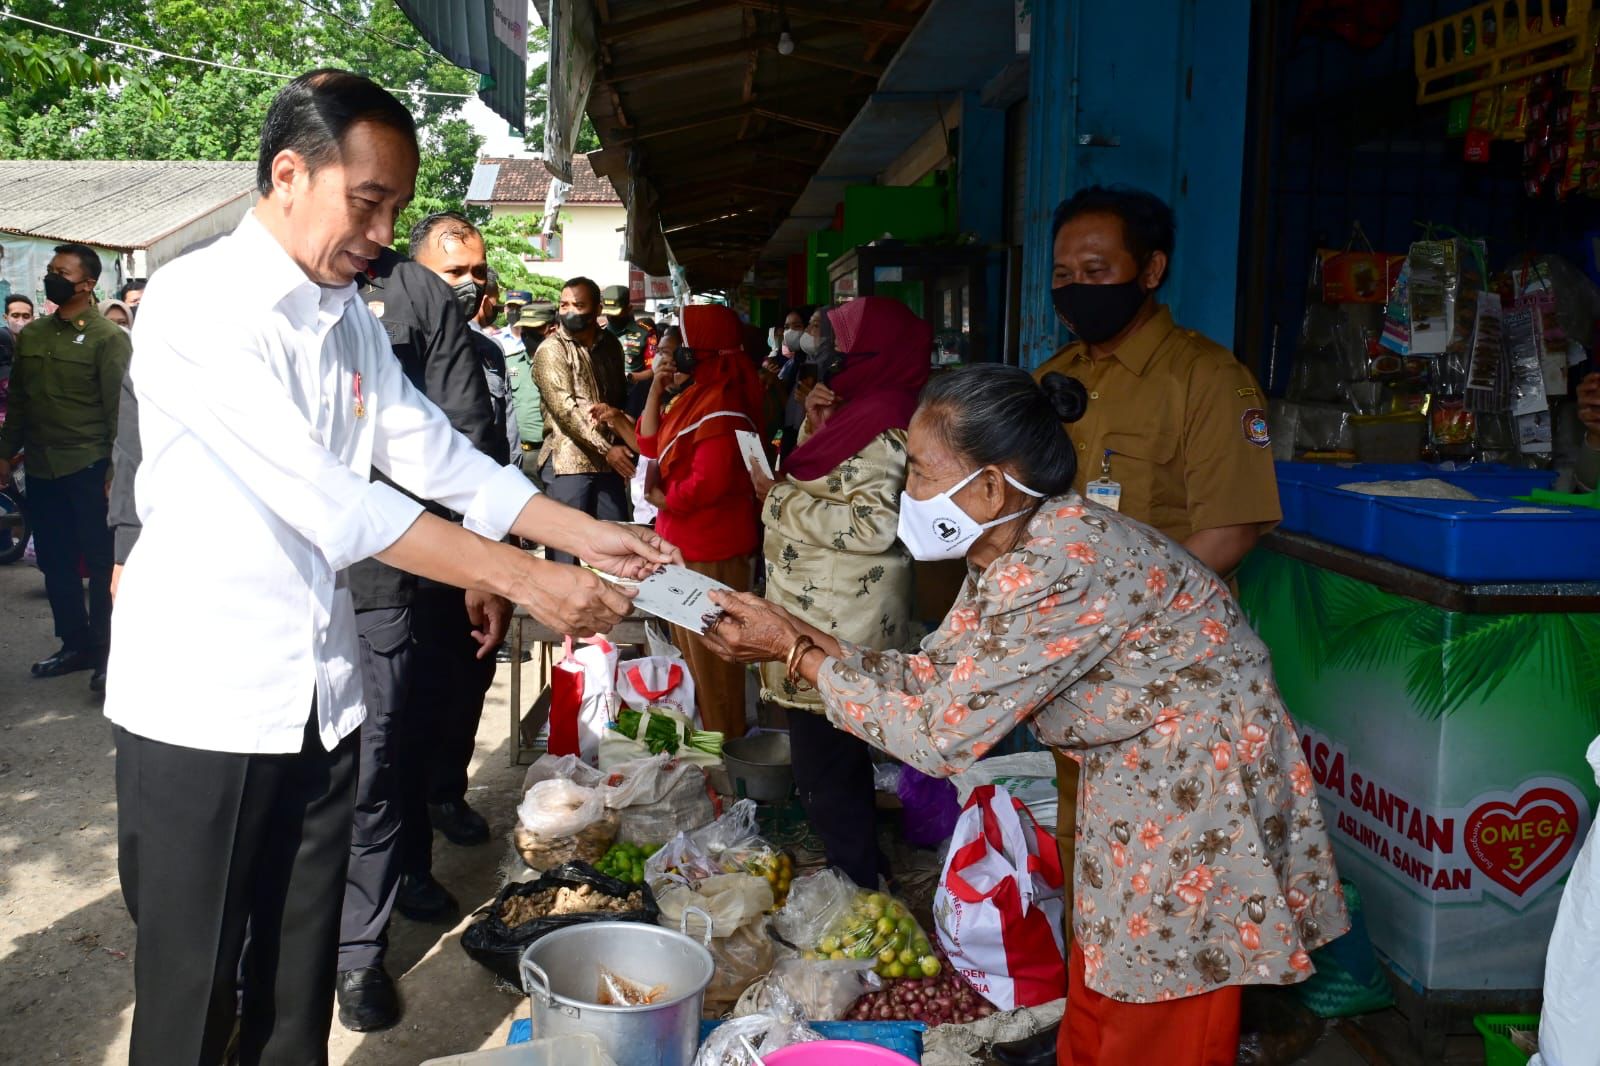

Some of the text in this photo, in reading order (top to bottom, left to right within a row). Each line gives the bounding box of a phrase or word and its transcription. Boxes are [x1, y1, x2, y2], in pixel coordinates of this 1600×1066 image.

[1351, 773, 1455, 854] SANTAN
[1481, 818, 1571, 845] OMEGA
[1337, 811, 1472, 891] ASLINYA SANTAN
[1508, 847, 1525, 870] 3
